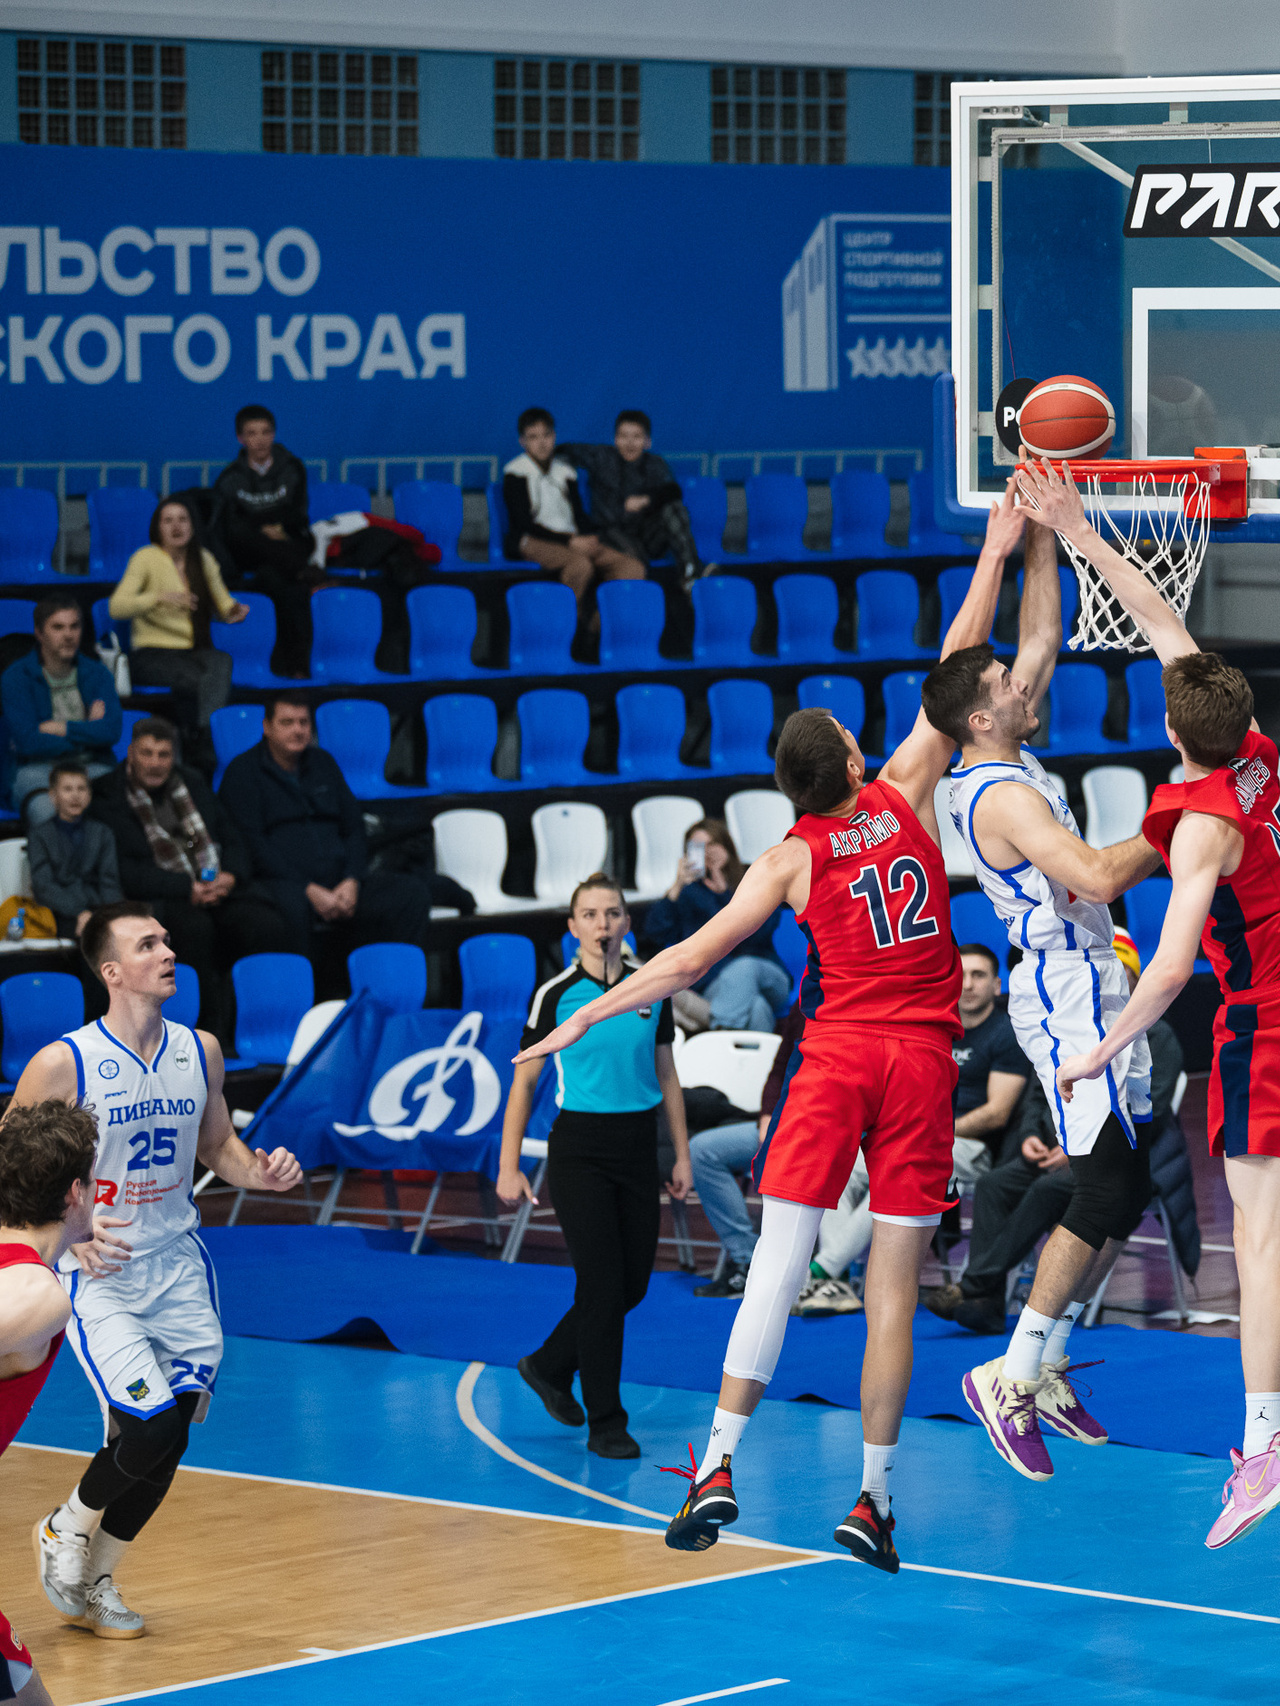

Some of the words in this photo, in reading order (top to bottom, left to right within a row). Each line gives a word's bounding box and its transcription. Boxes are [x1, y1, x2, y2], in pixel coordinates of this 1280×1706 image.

[0, 226, 321, 297] ЛЬСТВО
[0, 313, 231, 385] КОГО
[256, 313, 467, 381] КРАЯ
[848, 855, 940, 950] 12
[108, 1098, 196, 1127] ДИНАМО
[127, 1127, 178, 1172] 25
